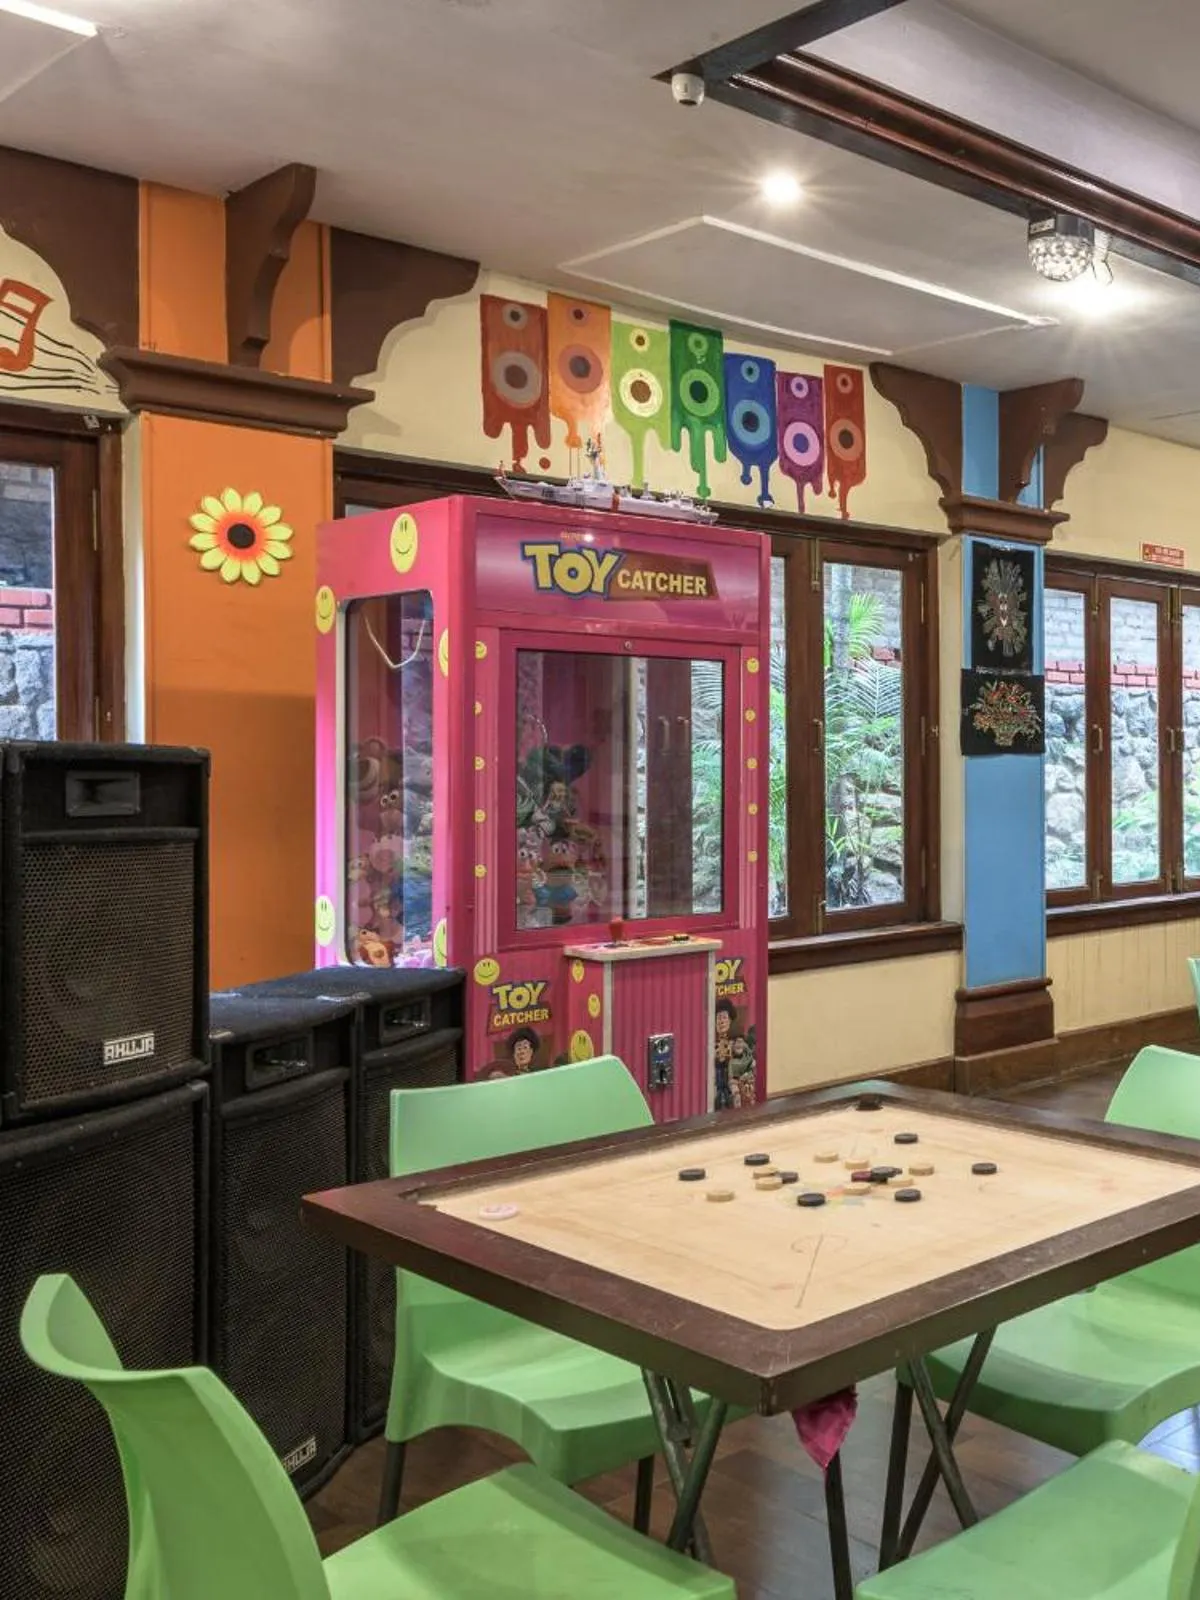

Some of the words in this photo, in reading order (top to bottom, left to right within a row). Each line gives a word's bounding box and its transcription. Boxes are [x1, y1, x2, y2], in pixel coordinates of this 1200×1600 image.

[521, 542, 622, 597] TOY
[617, 568, 707, 596] CATCHER
[715, 959, 741, 983] OY
[493, 981, 547, 1010] TOY
[493, 1008, 549, 1027] CATCHER
[103, 1036, 155, 1061] AHUJA
